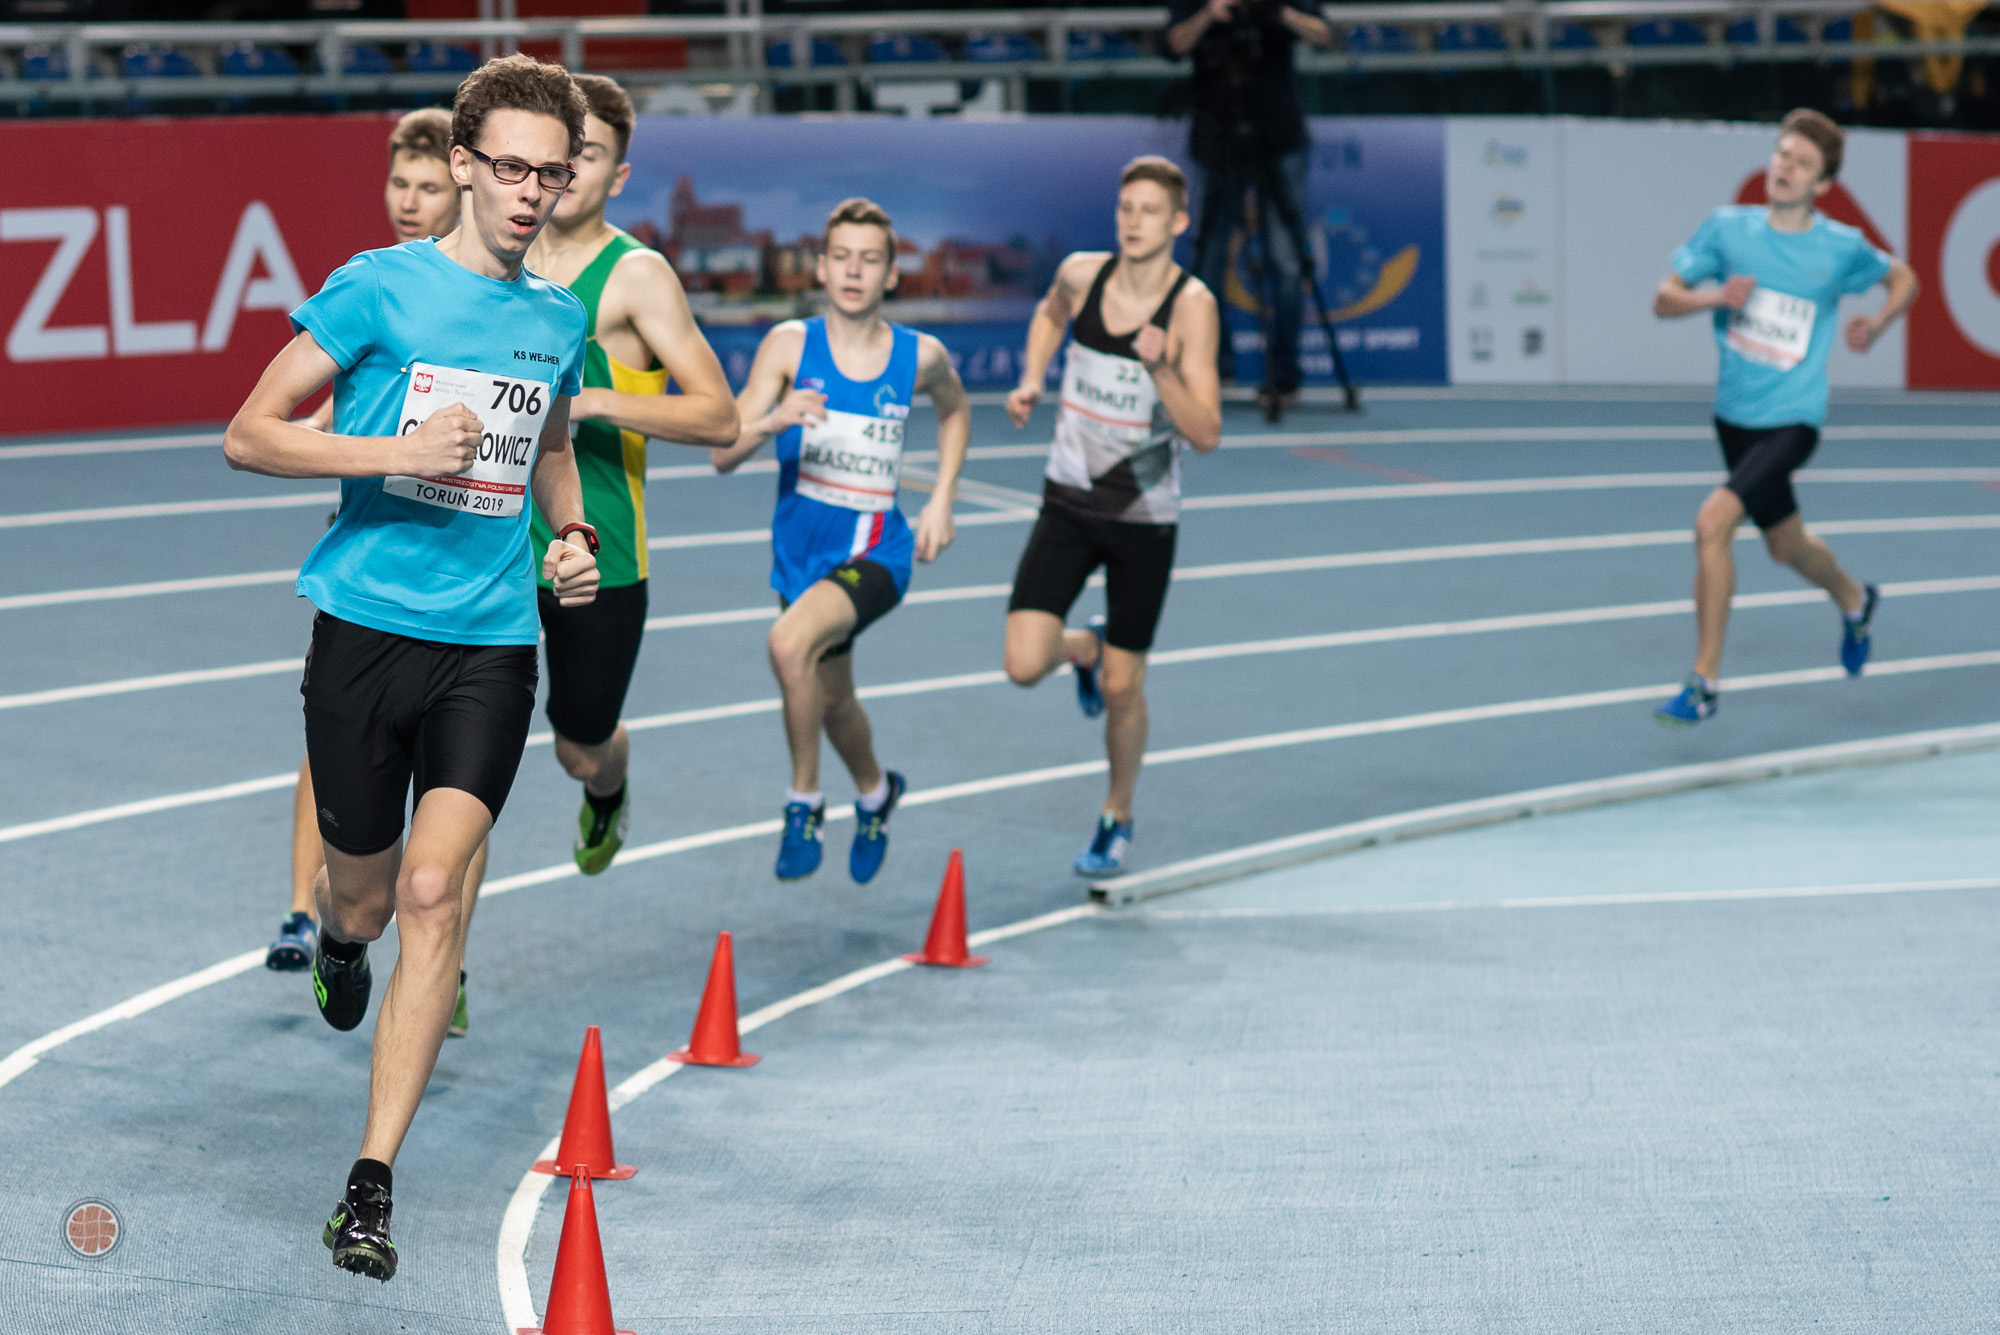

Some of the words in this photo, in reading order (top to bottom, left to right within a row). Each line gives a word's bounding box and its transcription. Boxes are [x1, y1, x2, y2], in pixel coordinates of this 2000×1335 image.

[514, 350, 527, 360] KS
[529, 352, 560, 366] WEJHER
[490, 380, 542, 416] 706
[862, 422, 903, 444] 415
[440, 476, 487, 489] MISTRZOSTWA
[416, 484, 470, 507] TORUŃ
[472, 496, 504, 512] 2019
